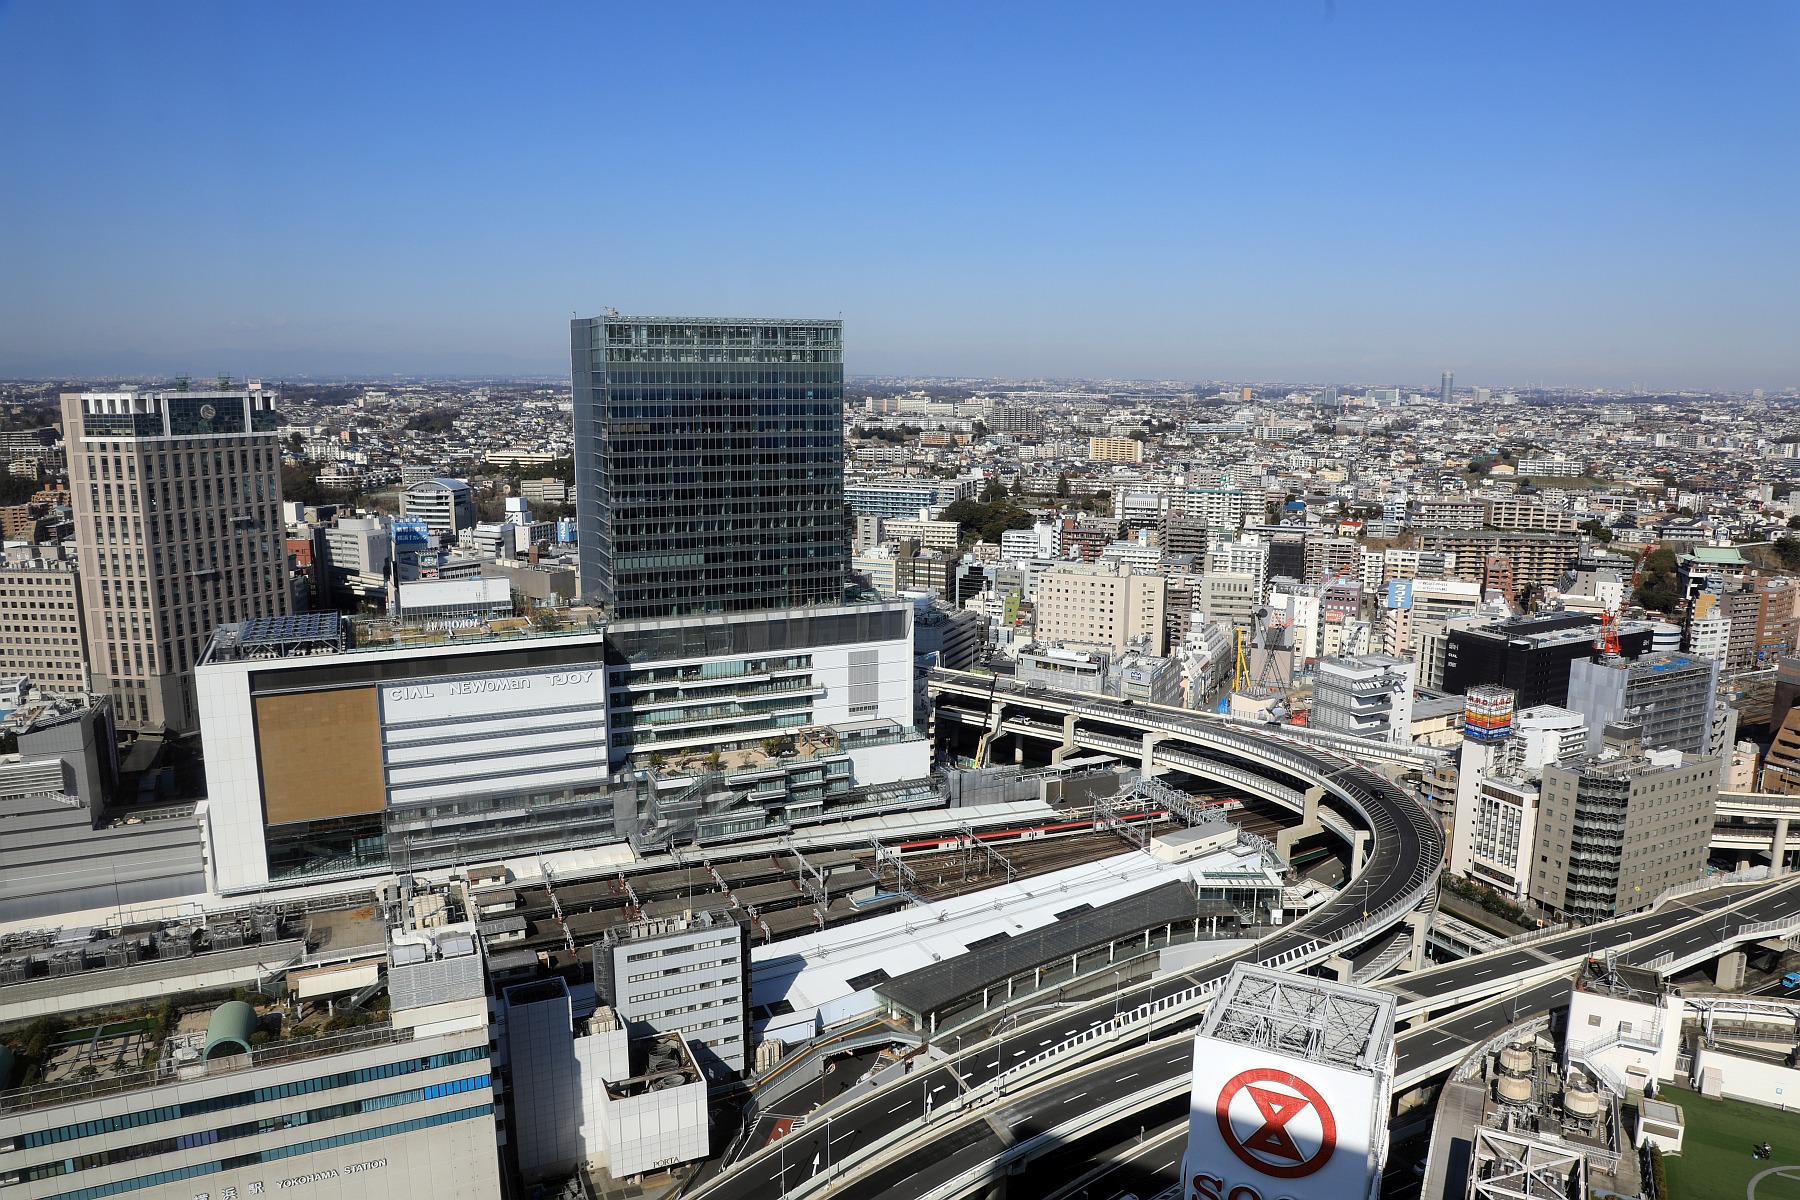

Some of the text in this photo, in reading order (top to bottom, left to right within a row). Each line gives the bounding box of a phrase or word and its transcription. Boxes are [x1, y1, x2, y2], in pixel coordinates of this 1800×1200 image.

[389, 686, 434, 701] CIAL
[449, 677, 531, 695] NEWoMan
[276, 1158, 387, 1189] YOKOHAMA STATION
[653, 1156, 680, 1168] PORTA
